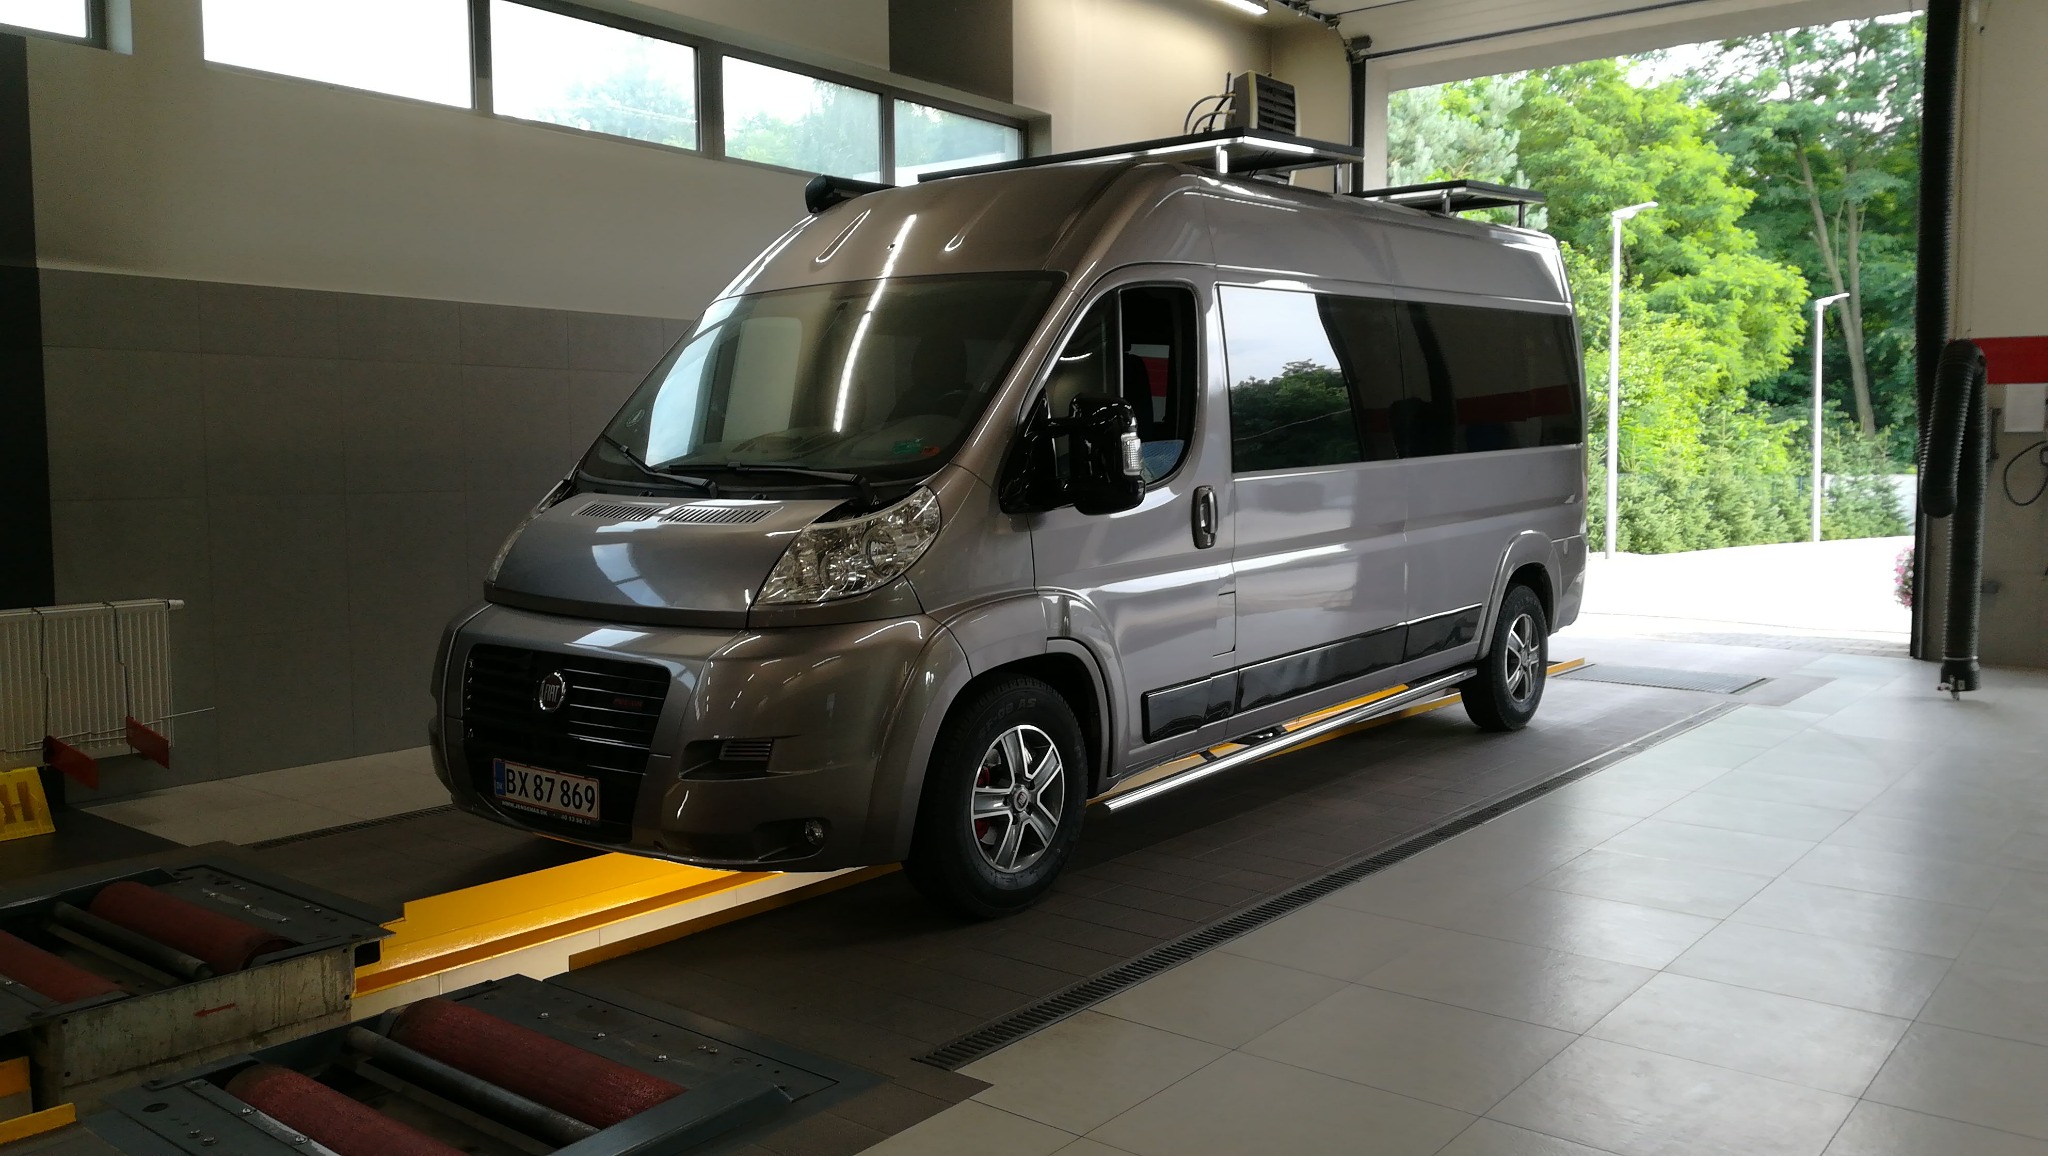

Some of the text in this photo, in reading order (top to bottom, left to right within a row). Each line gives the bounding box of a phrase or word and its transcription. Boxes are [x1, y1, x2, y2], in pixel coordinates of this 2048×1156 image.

[544, 683, 561, 702] FIAT
[506, 768, 595, 813] BX 87 869
